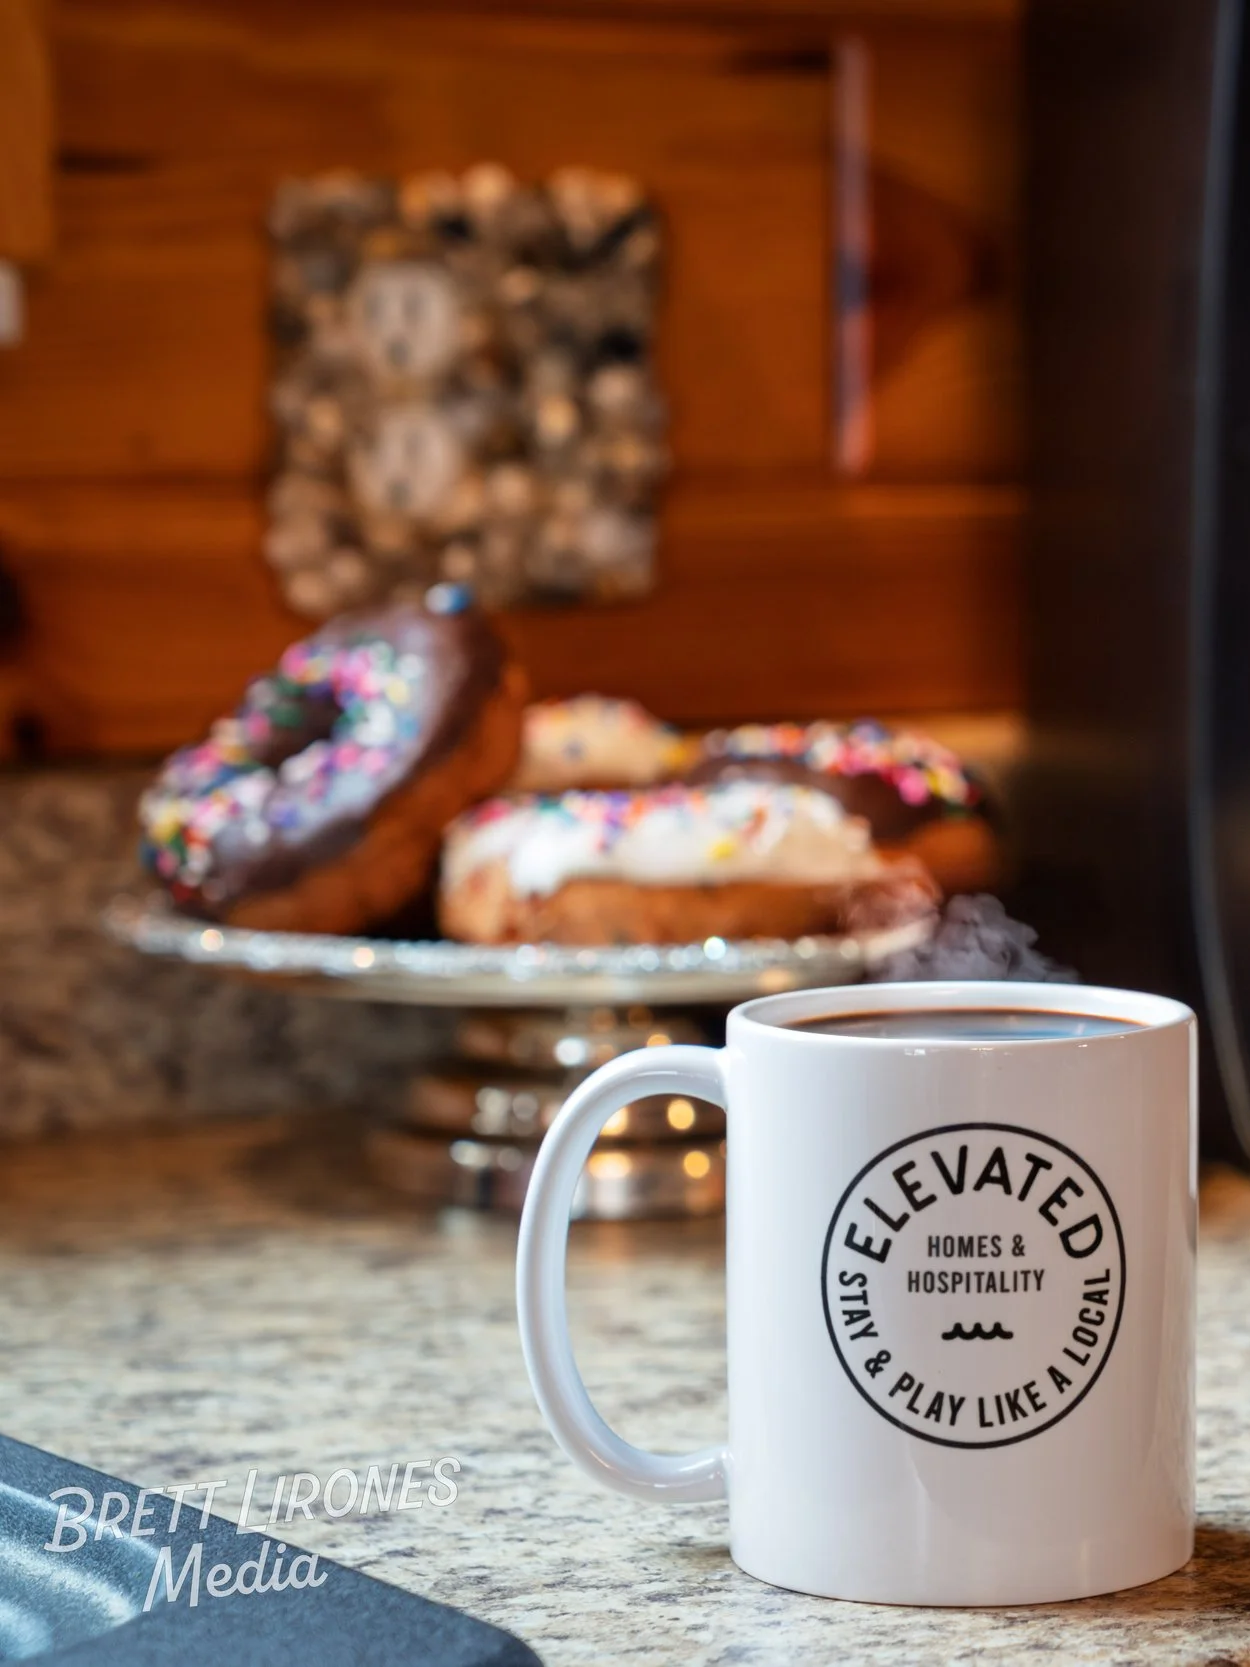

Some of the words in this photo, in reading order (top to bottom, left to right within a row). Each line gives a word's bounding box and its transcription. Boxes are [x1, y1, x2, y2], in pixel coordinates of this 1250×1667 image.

[844, 1145, 1104, 1263] ELEVATED
[908, 1269, 1045, 1293] HOSPITALITY
[927, 1235, 1002, 1258] HOMES
[1011, 1234, 1026, 1257] &
[839, 1270, 878, 1340] STAY
[864, 1349, 891, 1378] &
[888, 1372, 965, 1426] PLAY
[979, 1380, 1047, 1428] LIKE
[1047, 1365, 1072, 1394] A
[1063, 1268, 1110, 1366] LOCAL
